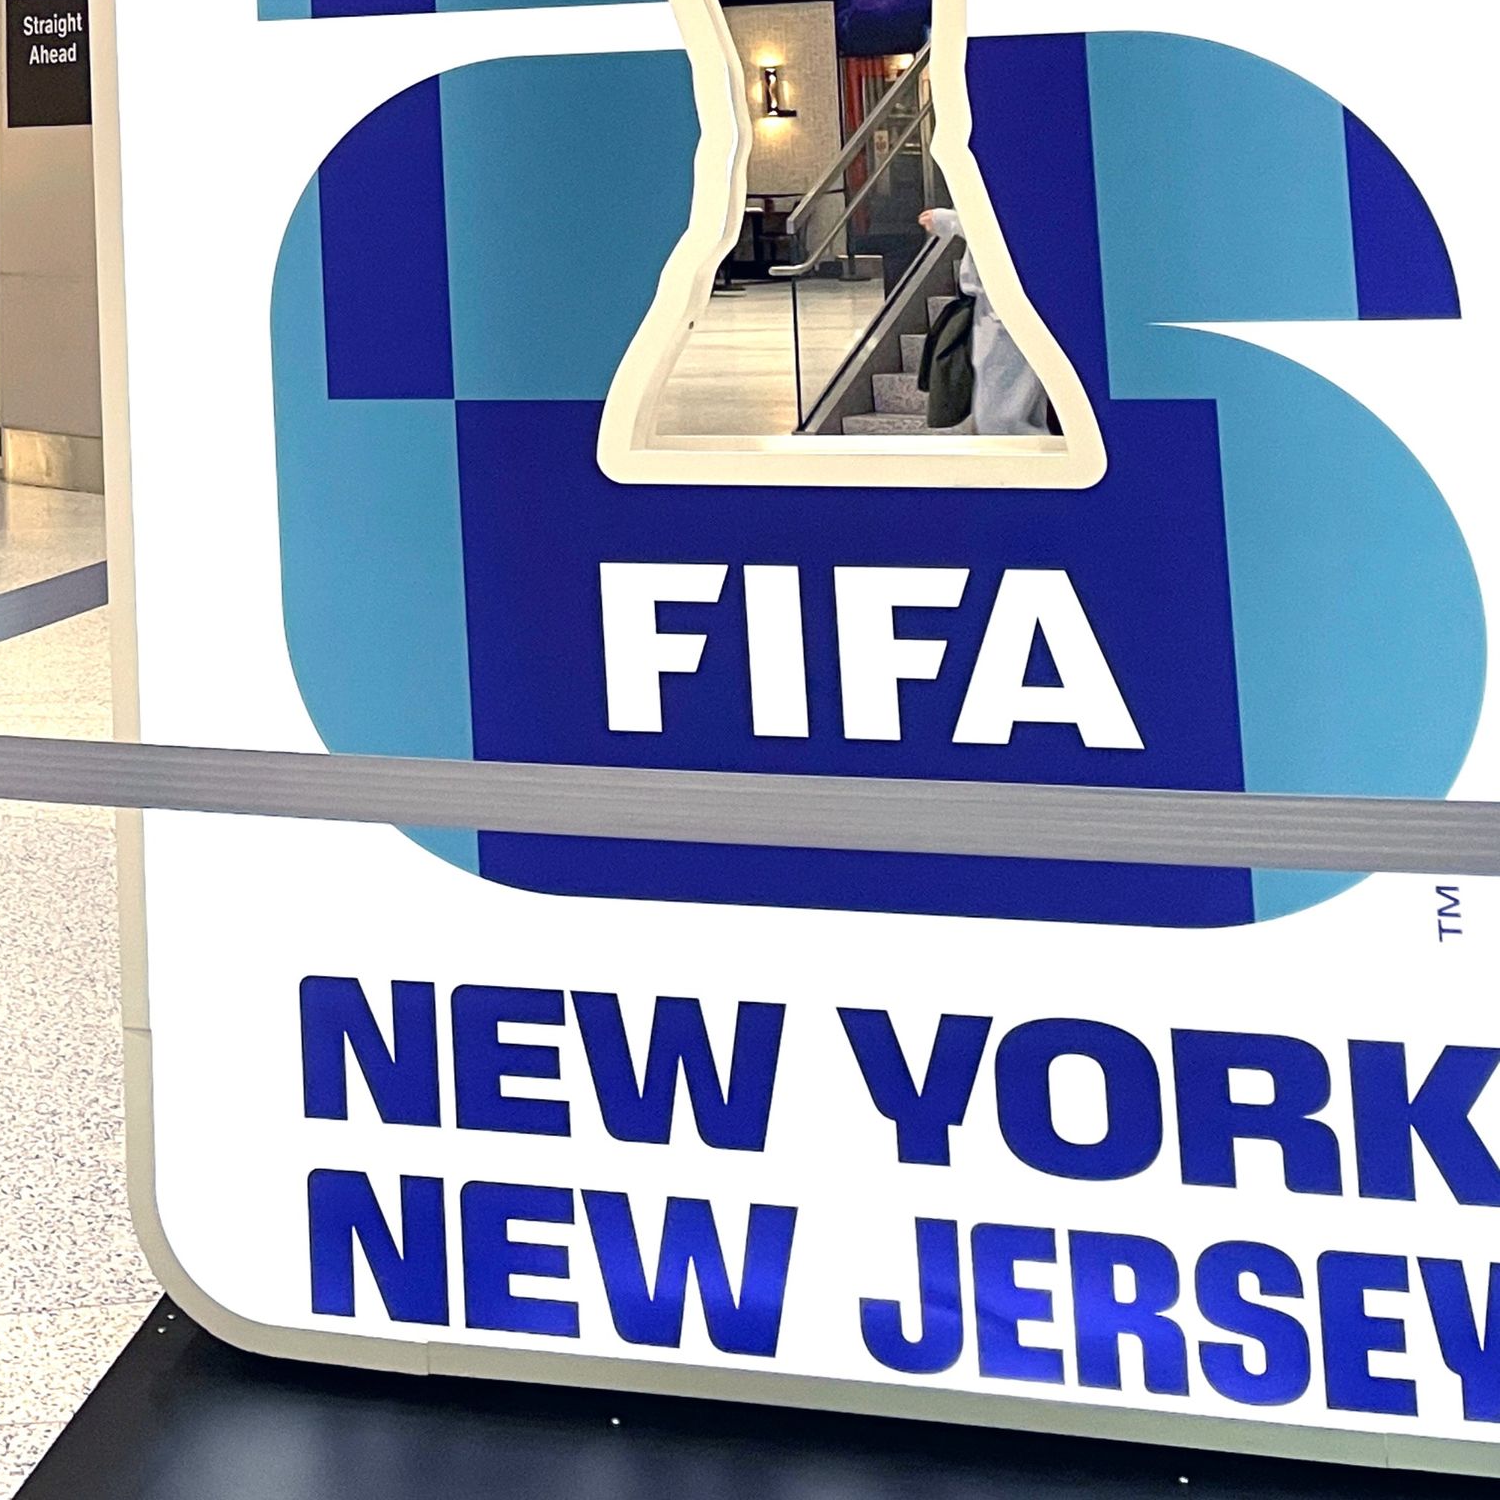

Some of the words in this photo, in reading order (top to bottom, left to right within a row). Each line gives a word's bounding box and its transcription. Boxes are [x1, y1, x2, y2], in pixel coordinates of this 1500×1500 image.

[23, 12, 83, 38] Straight
[29, 43, 77, 65] Ahead
[599, 561, 1146, 751] FIFA
[299, 975, 787, 1153] NEW
[836, 1007, 1500, 1208] YORK
[306, 1168, 799, 1359] NEW
